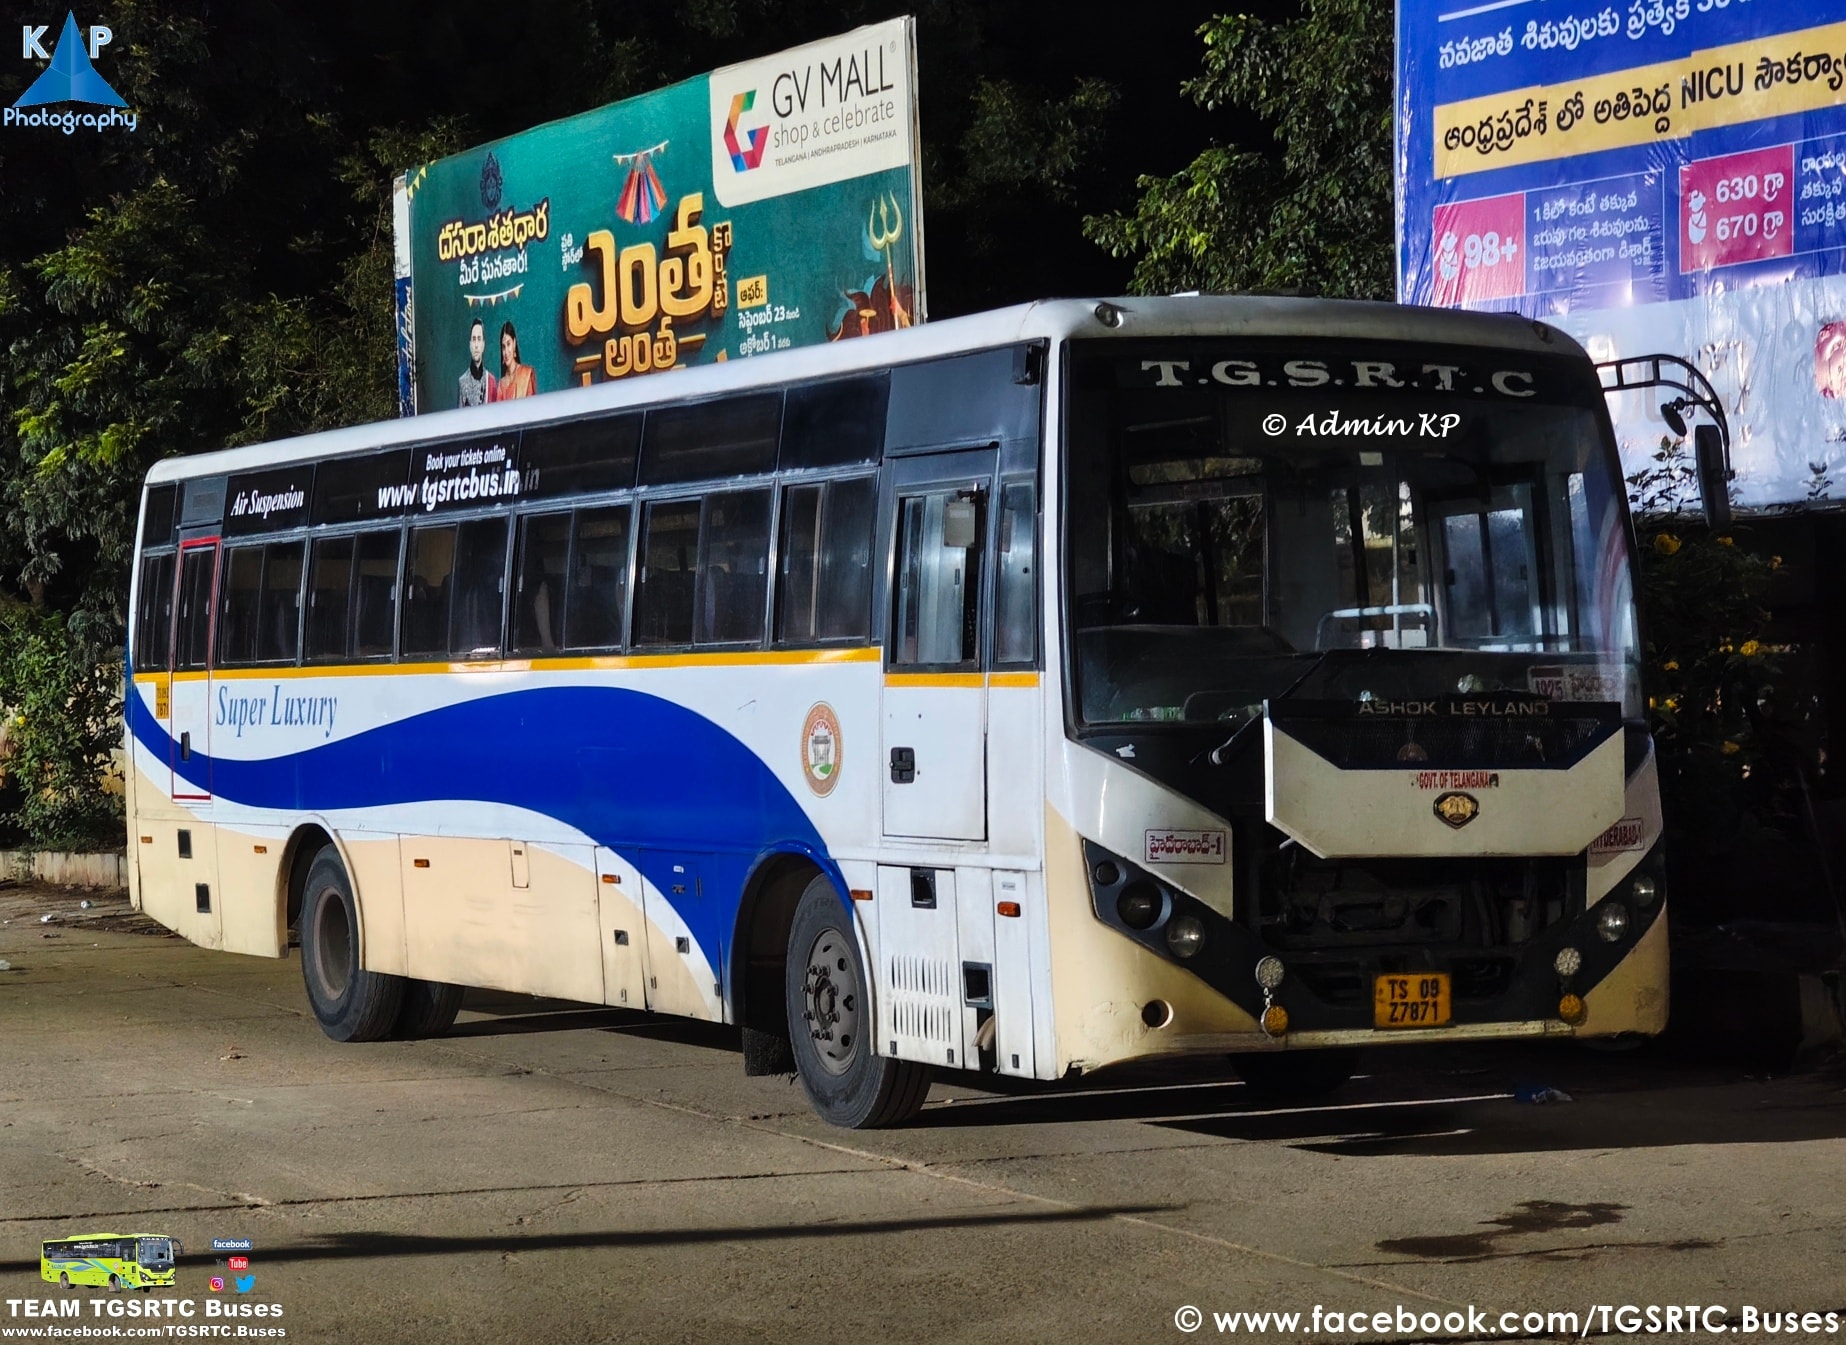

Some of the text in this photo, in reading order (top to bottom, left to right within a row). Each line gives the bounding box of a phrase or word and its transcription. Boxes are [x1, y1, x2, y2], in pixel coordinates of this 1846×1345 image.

[1439, 26, 1513, 69] నవజాత
[1521, 7, 1620, 51] శిశువులకు
[772, 45, 894, 118] GV MALL
[1444, 51, 1846, 155] ఆంధ్రప్రదేశ్ లో అతిపెద్ద NICU సౌకర్యా
[774, 100, 895, 149] shop & celebrate
[775, 129, 897, 167] TELANGANA ANDHRAPRADESH KARNATAKA
[1600, 190, 1638, 212] తక్కువ
[1716, 173, 1785, 203] 630 గ్రా
[1716, 211, 1784, 241] 670 గ్రా
[774, 305, 785, 322] 23
[771, 334, 776, 350] 1
[425, 444, 506, 472] Book your tickets online
[231, 484, 304, 519] Air Suspension
[216, 684, 338, 738] Super Luxury
[1359, 700, 1549, 716] ASHOK LEYLAND
[1419, 771, 1490, 789] GOVT. OF TELANGANA
[1388, 979, 1408, 1000] TS
[1389, 1000, 1438, 1023] Z7871
